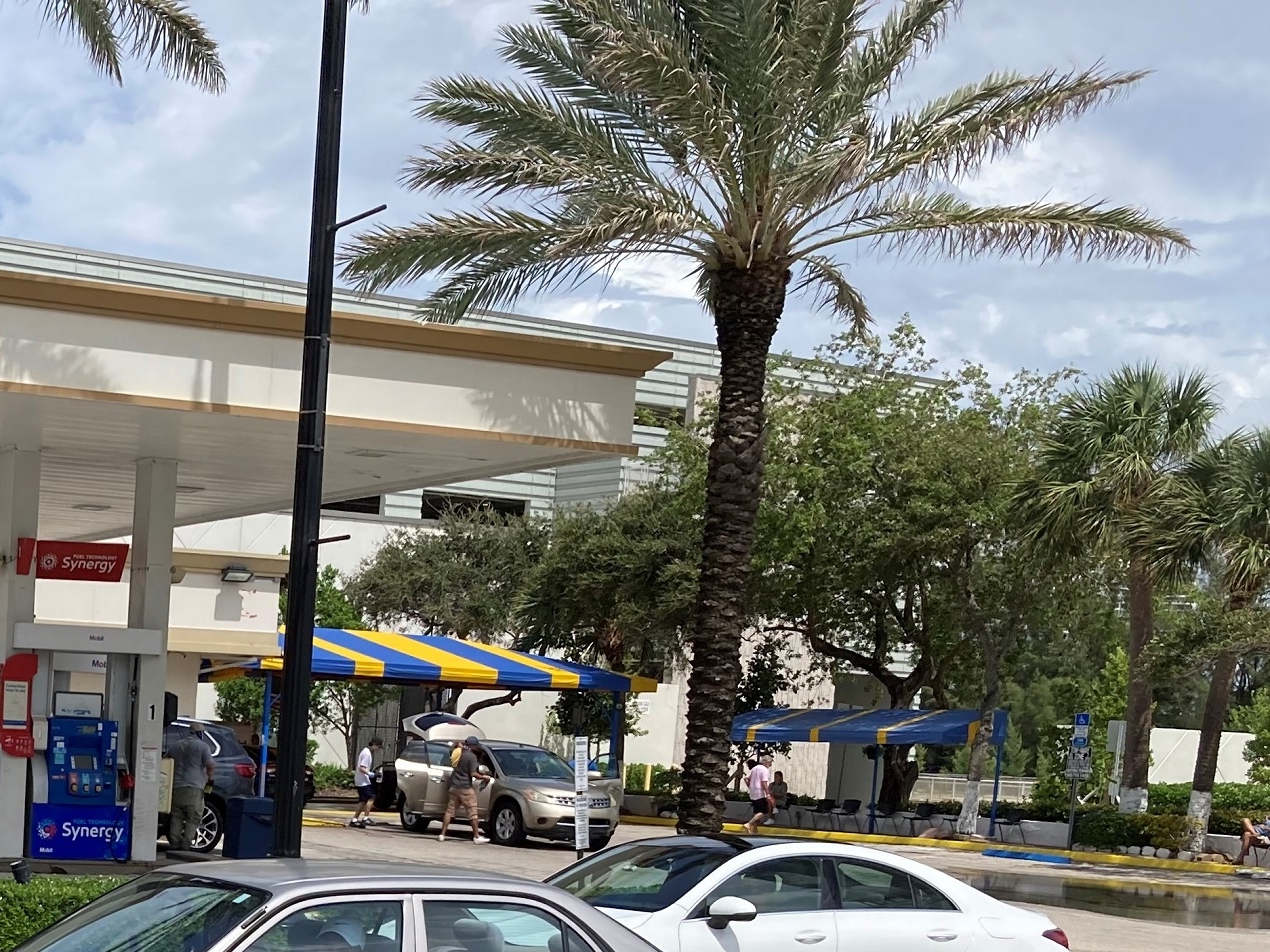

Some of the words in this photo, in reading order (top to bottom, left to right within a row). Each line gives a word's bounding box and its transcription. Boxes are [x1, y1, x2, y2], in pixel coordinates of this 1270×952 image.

[62, 556, 117, 573] Synergy
[92, 659, 107, 668] Mob
[149, 704, 155, 720] 1
[62, 822, 124, 842] Synergy
